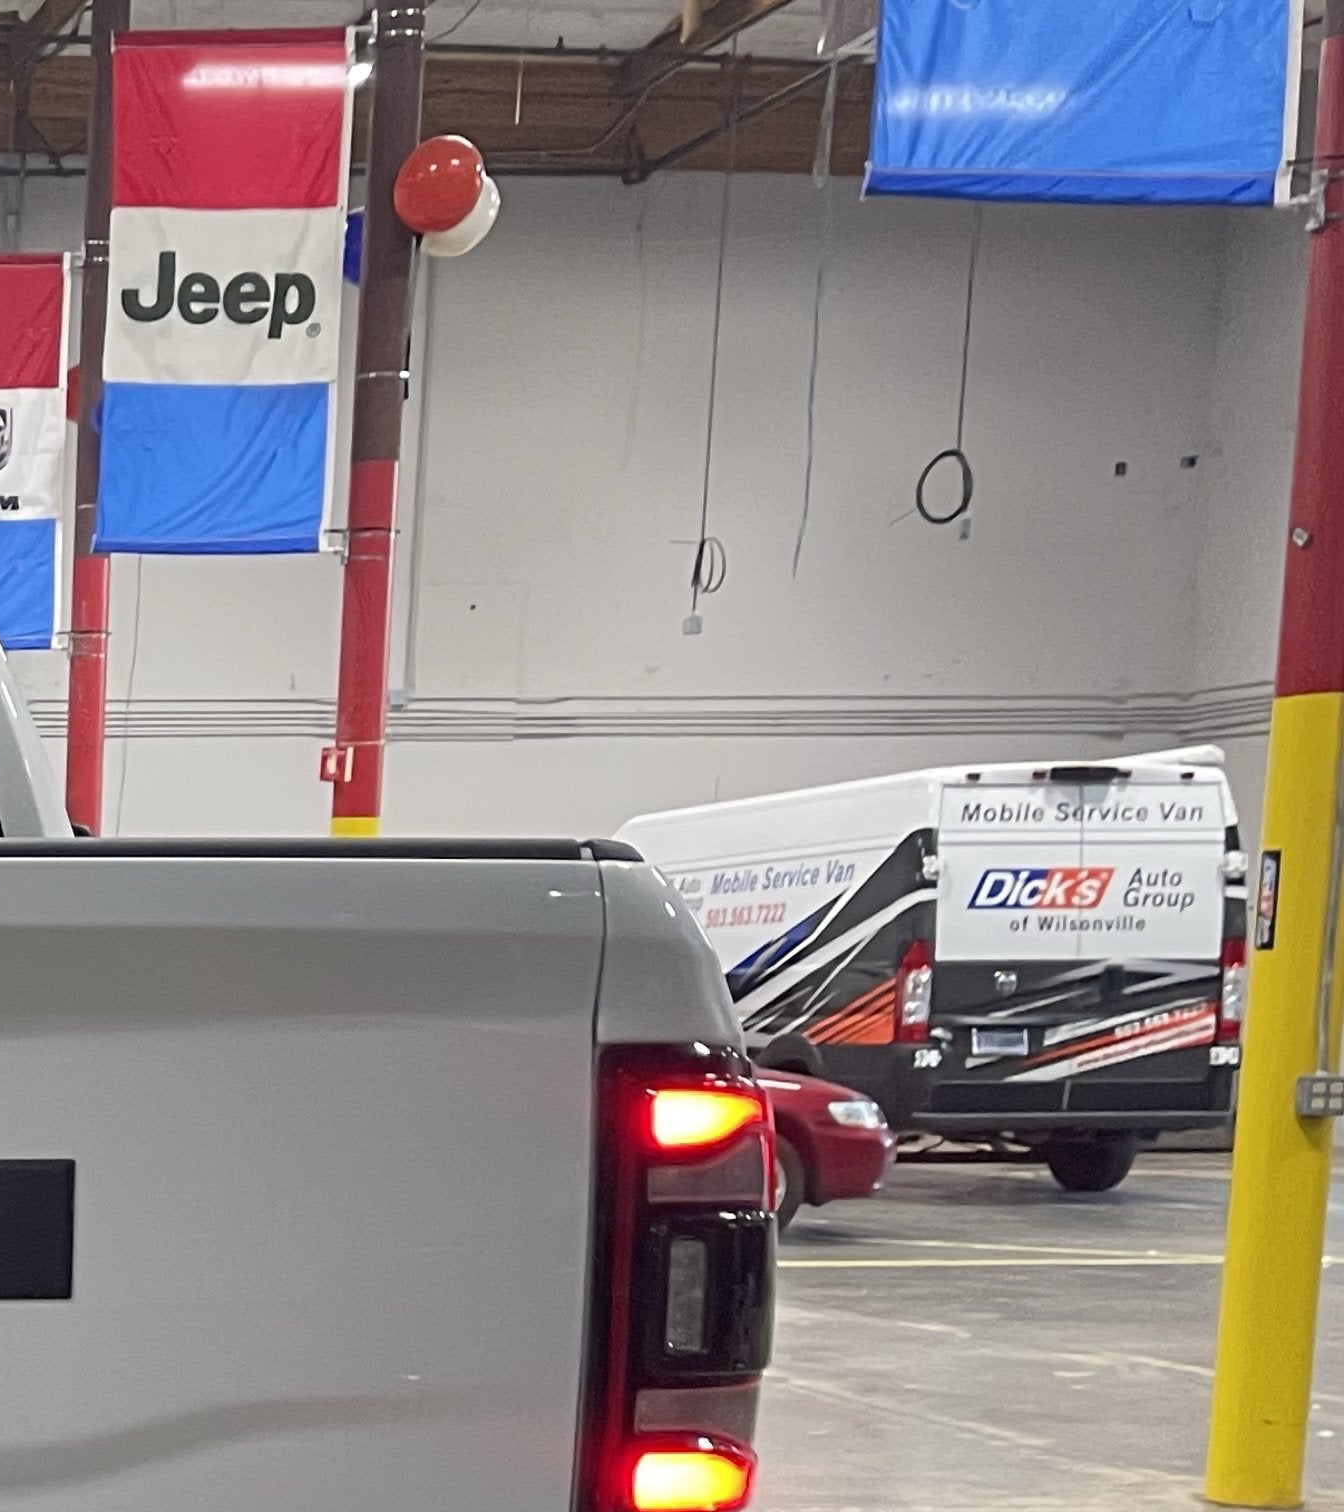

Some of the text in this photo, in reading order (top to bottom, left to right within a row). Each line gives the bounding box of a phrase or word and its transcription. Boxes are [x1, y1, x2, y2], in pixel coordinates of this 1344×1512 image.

[121, 251, 315, 339] Jeep
[960, 802, 1204, 823] Mobile Service Van
[710, 868, 759, 895] Mobile
[761, 861, 820, 889] Service
[825, 859, 856, 884] Van
[973, 869, 1107, 909] Dick's
[1127, 867, 1183, 887] Auto
[1123, 887, 1195, 913] Group
[1009, 914, 1147, 932] of Wilsonville
